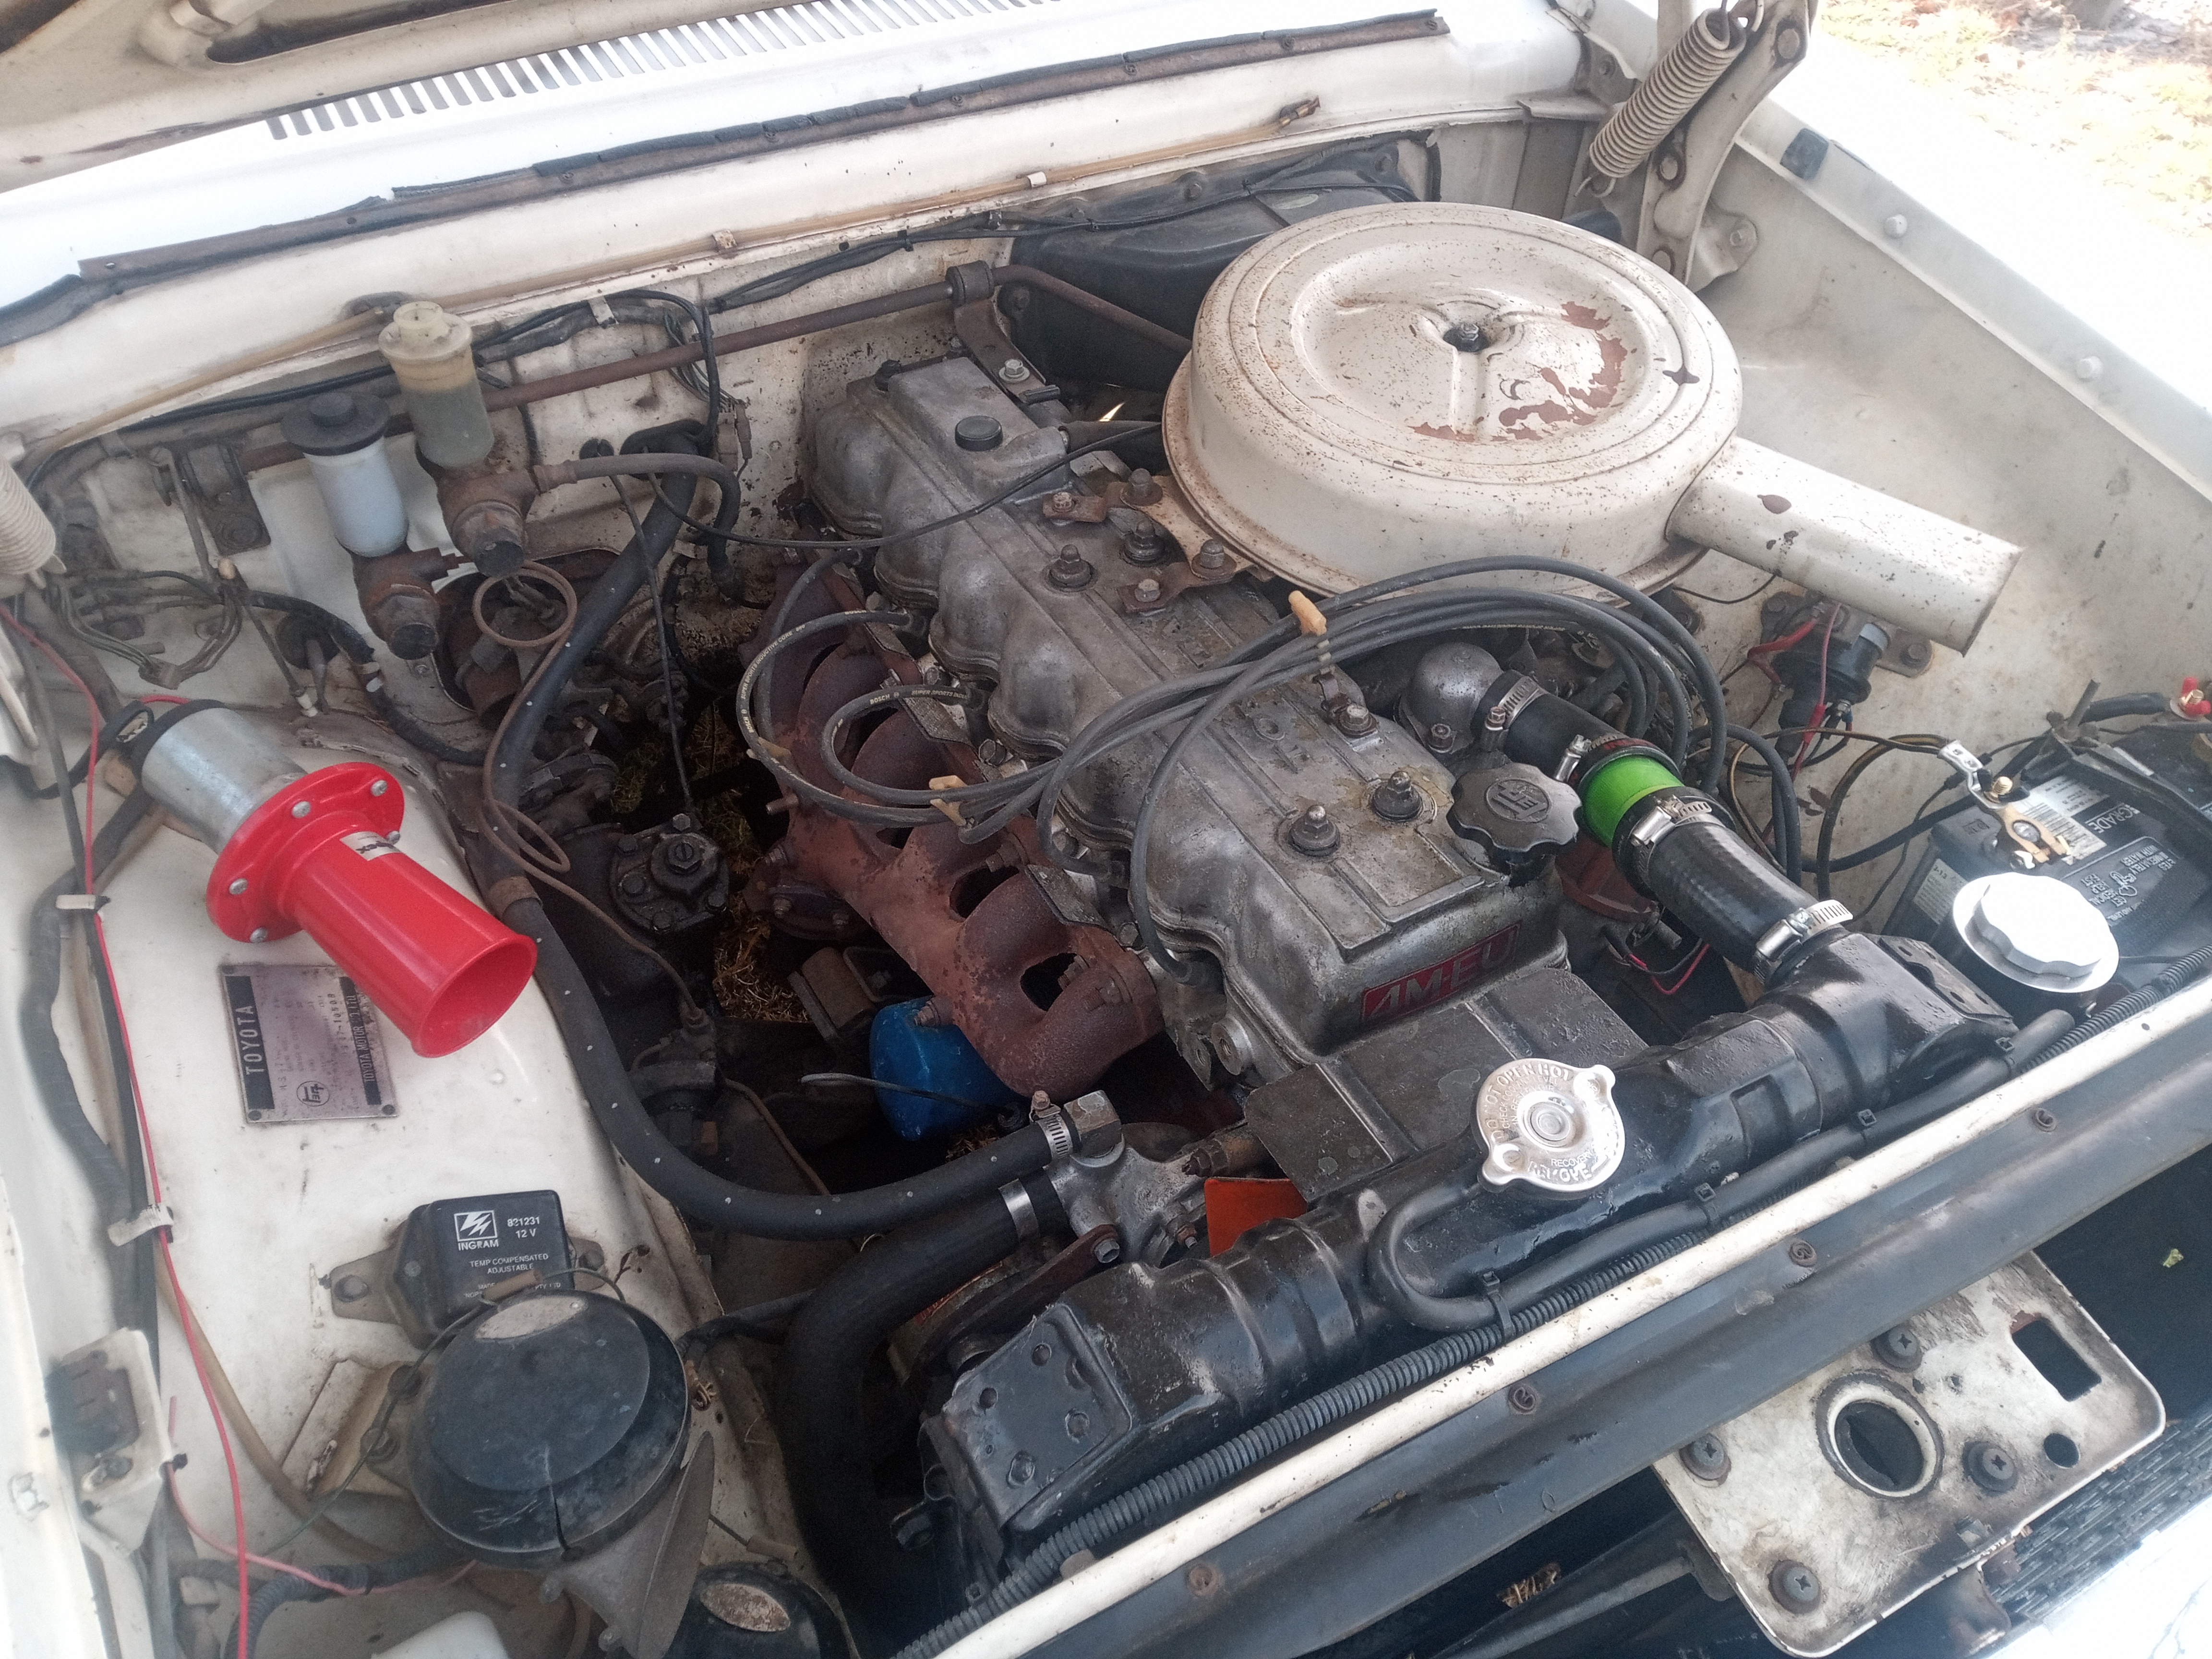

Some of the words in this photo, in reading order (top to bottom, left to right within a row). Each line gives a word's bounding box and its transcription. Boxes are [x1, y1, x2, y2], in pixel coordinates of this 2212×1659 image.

[746, 662, 758, 683] SPORTS
[778, 630, 793, 642] CORE
[870, 694, 890, 705] BOSCH
[237, 1005, 265, 1075] TOYOTA
[353, 1026, 368, 1052] MOTOR
[359, 1053, 375, 1082] TOYOTA
[1497, 1063, 1536, 1086] OPEN
[1500, 1101, 1510, 1129] CHECK
[1511, 1116, 1519, 1125] IN
[516, 1229, 528, 1238] 12
[529, 1228, 537, 1238] V
[457, 1239, 499, 1251] INGRAM
[469, 1259, 491, 1268] TEMP
[492, 1253, 549, 1266] COMPENSATED
[487, 1262, 535, 1274] ADJUSTABLE
